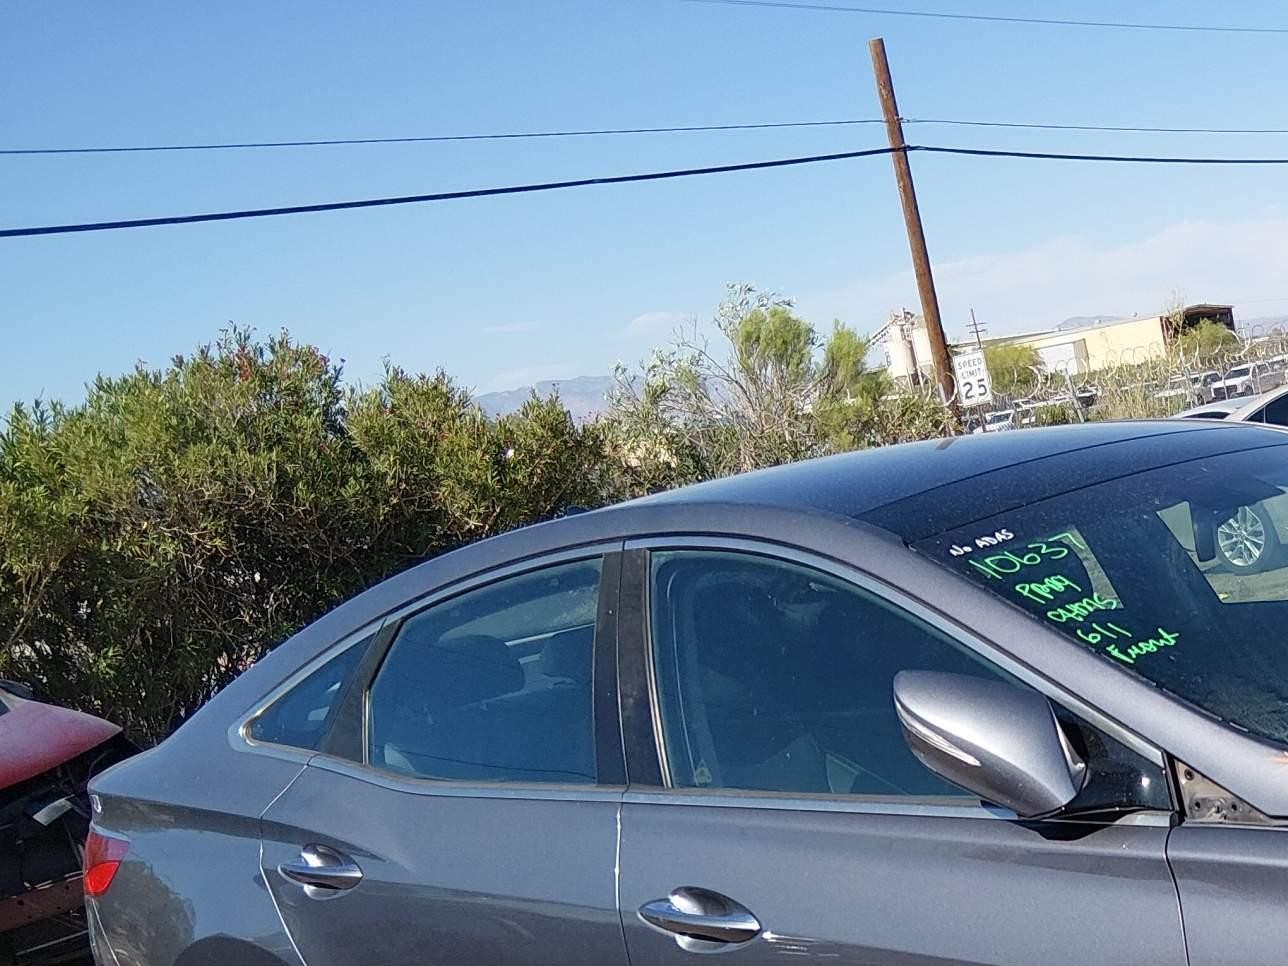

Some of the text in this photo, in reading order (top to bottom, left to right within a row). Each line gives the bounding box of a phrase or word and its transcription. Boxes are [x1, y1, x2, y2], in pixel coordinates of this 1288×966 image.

[957, 357, 983, 370] SPEED
[961, 367, 982, 379] LIMIT
[962, 378, 988, 400] 25
[975, 528, 1015, 549] ADAS
[968, 532, 1085, 580] 10637
